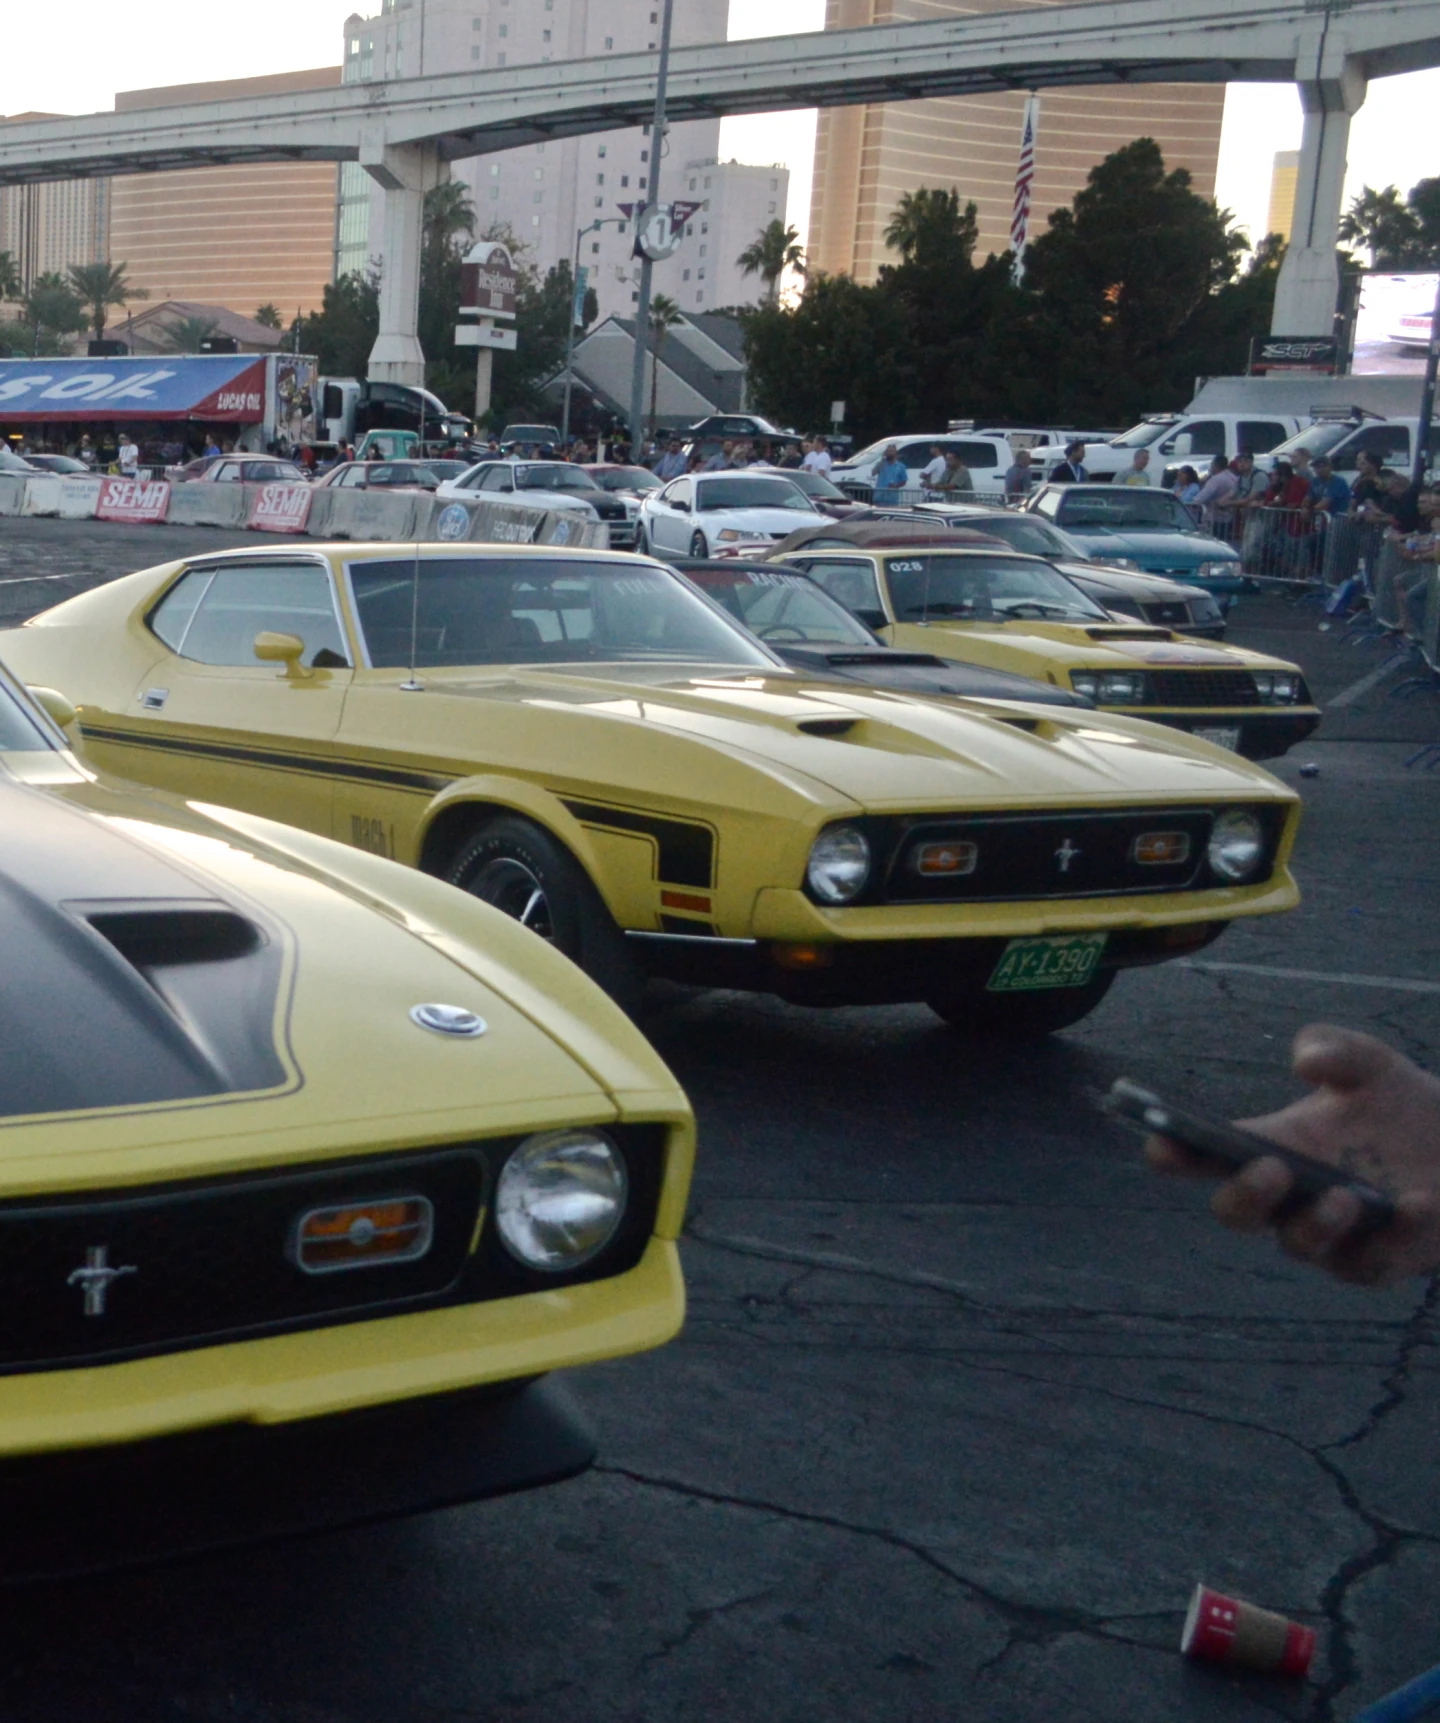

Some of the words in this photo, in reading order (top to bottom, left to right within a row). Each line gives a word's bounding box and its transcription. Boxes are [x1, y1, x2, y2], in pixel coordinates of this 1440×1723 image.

[656, 218, 666, 245] 1
[479, 268, 516, 294] Residence
[39, 371, 177, 401] OIL
[217, 392, 246, 411] LUCAS
[246, 393, 261, 411] OIL
[103, 482, 170, 508] SEMA
[257, 486, 311, 515] SEMA
